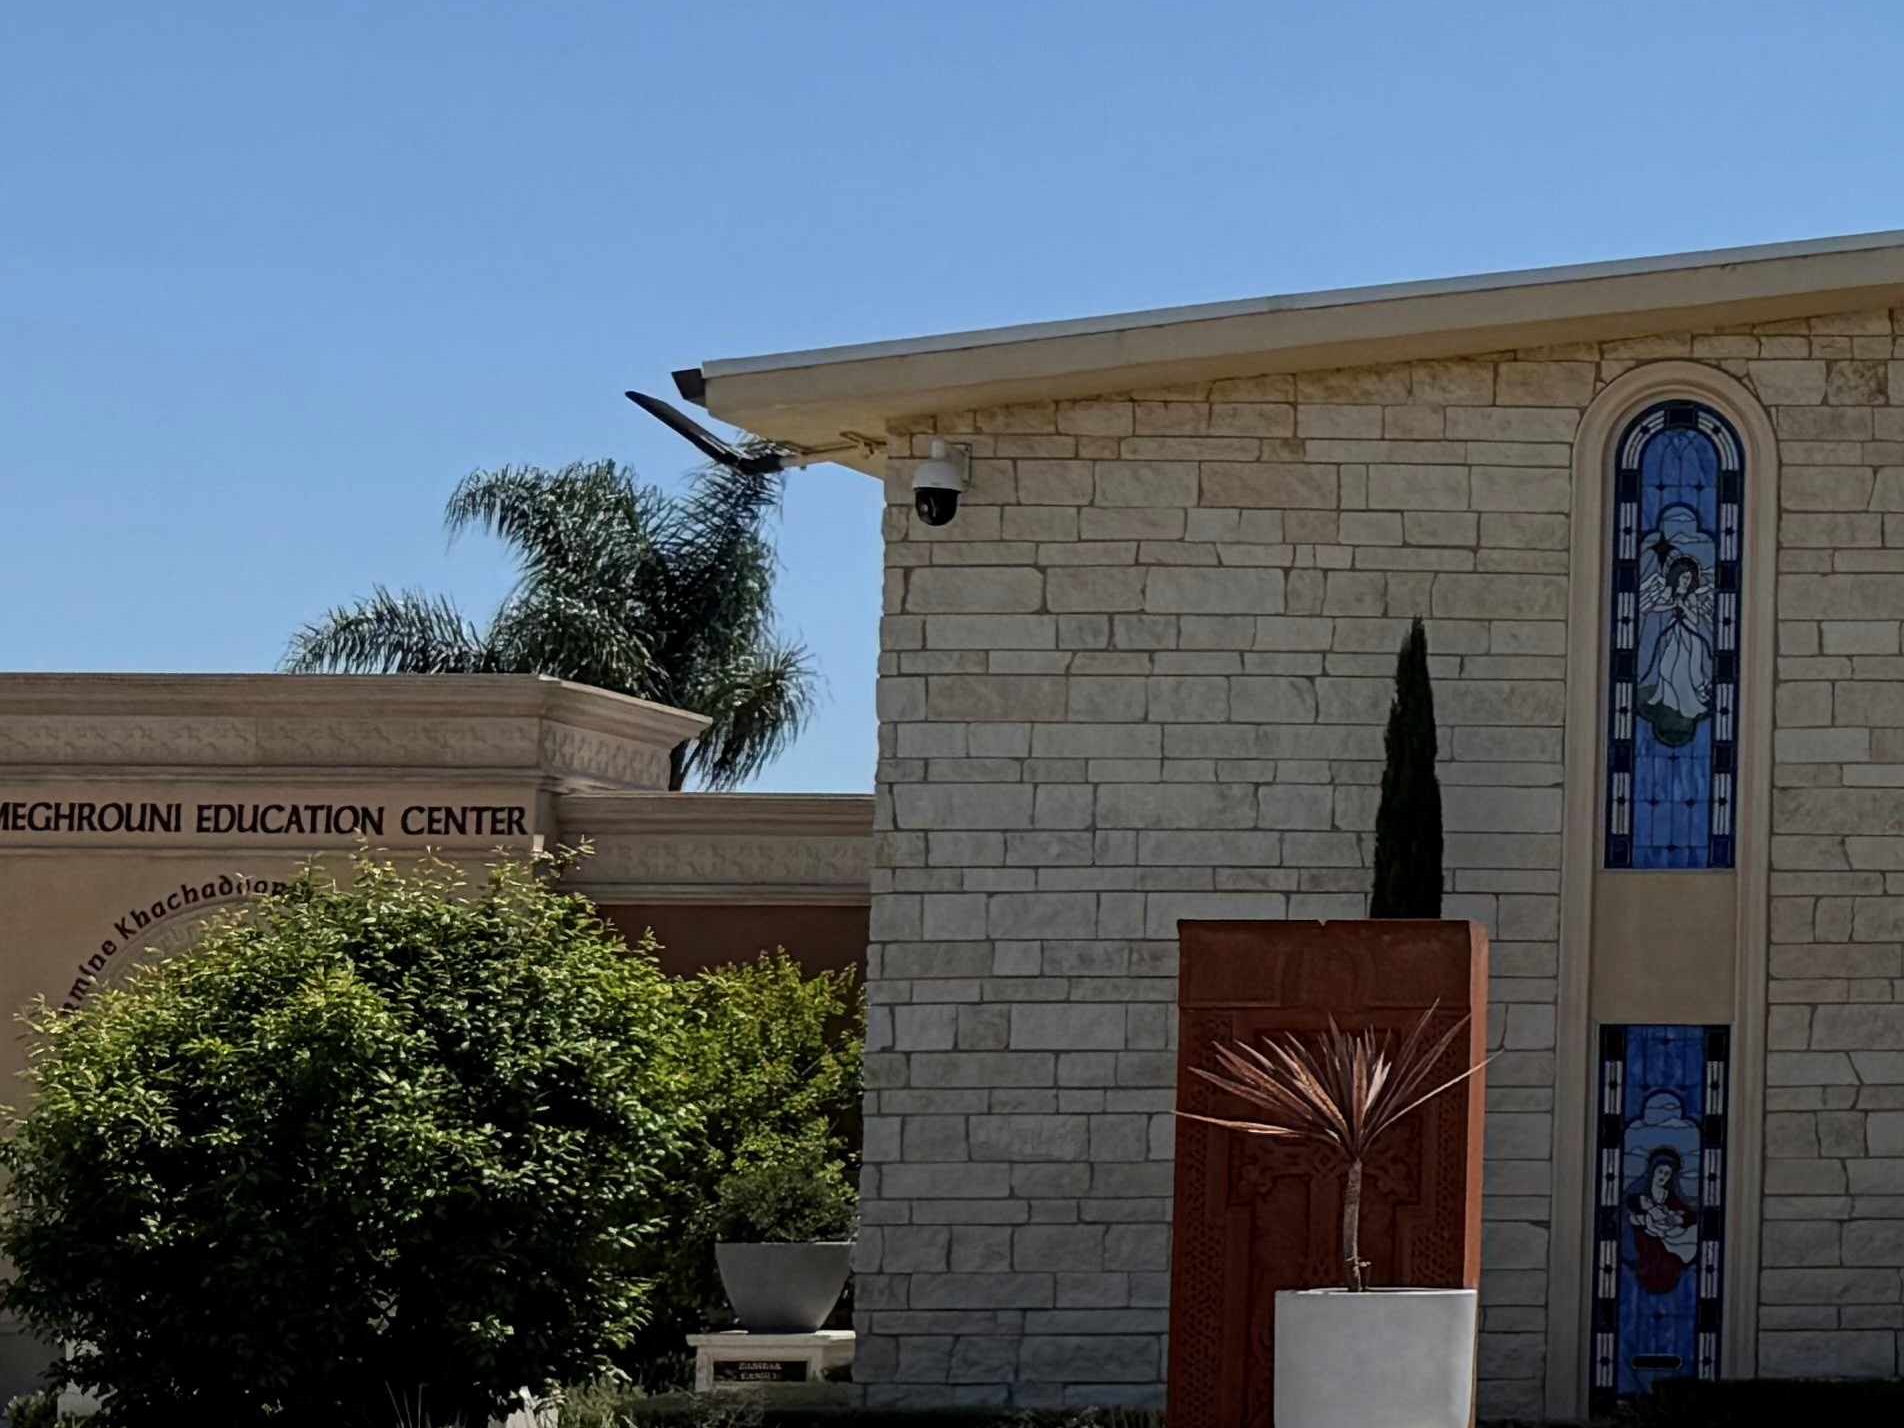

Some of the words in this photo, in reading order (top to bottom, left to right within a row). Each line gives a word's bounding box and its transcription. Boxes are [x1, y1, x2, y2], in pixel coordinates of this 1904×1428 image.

[196, 803, 385, 836] EDUCATION
[401, 805, 529, 836] CENTER
[59, 939, 118, 1016] rmine
